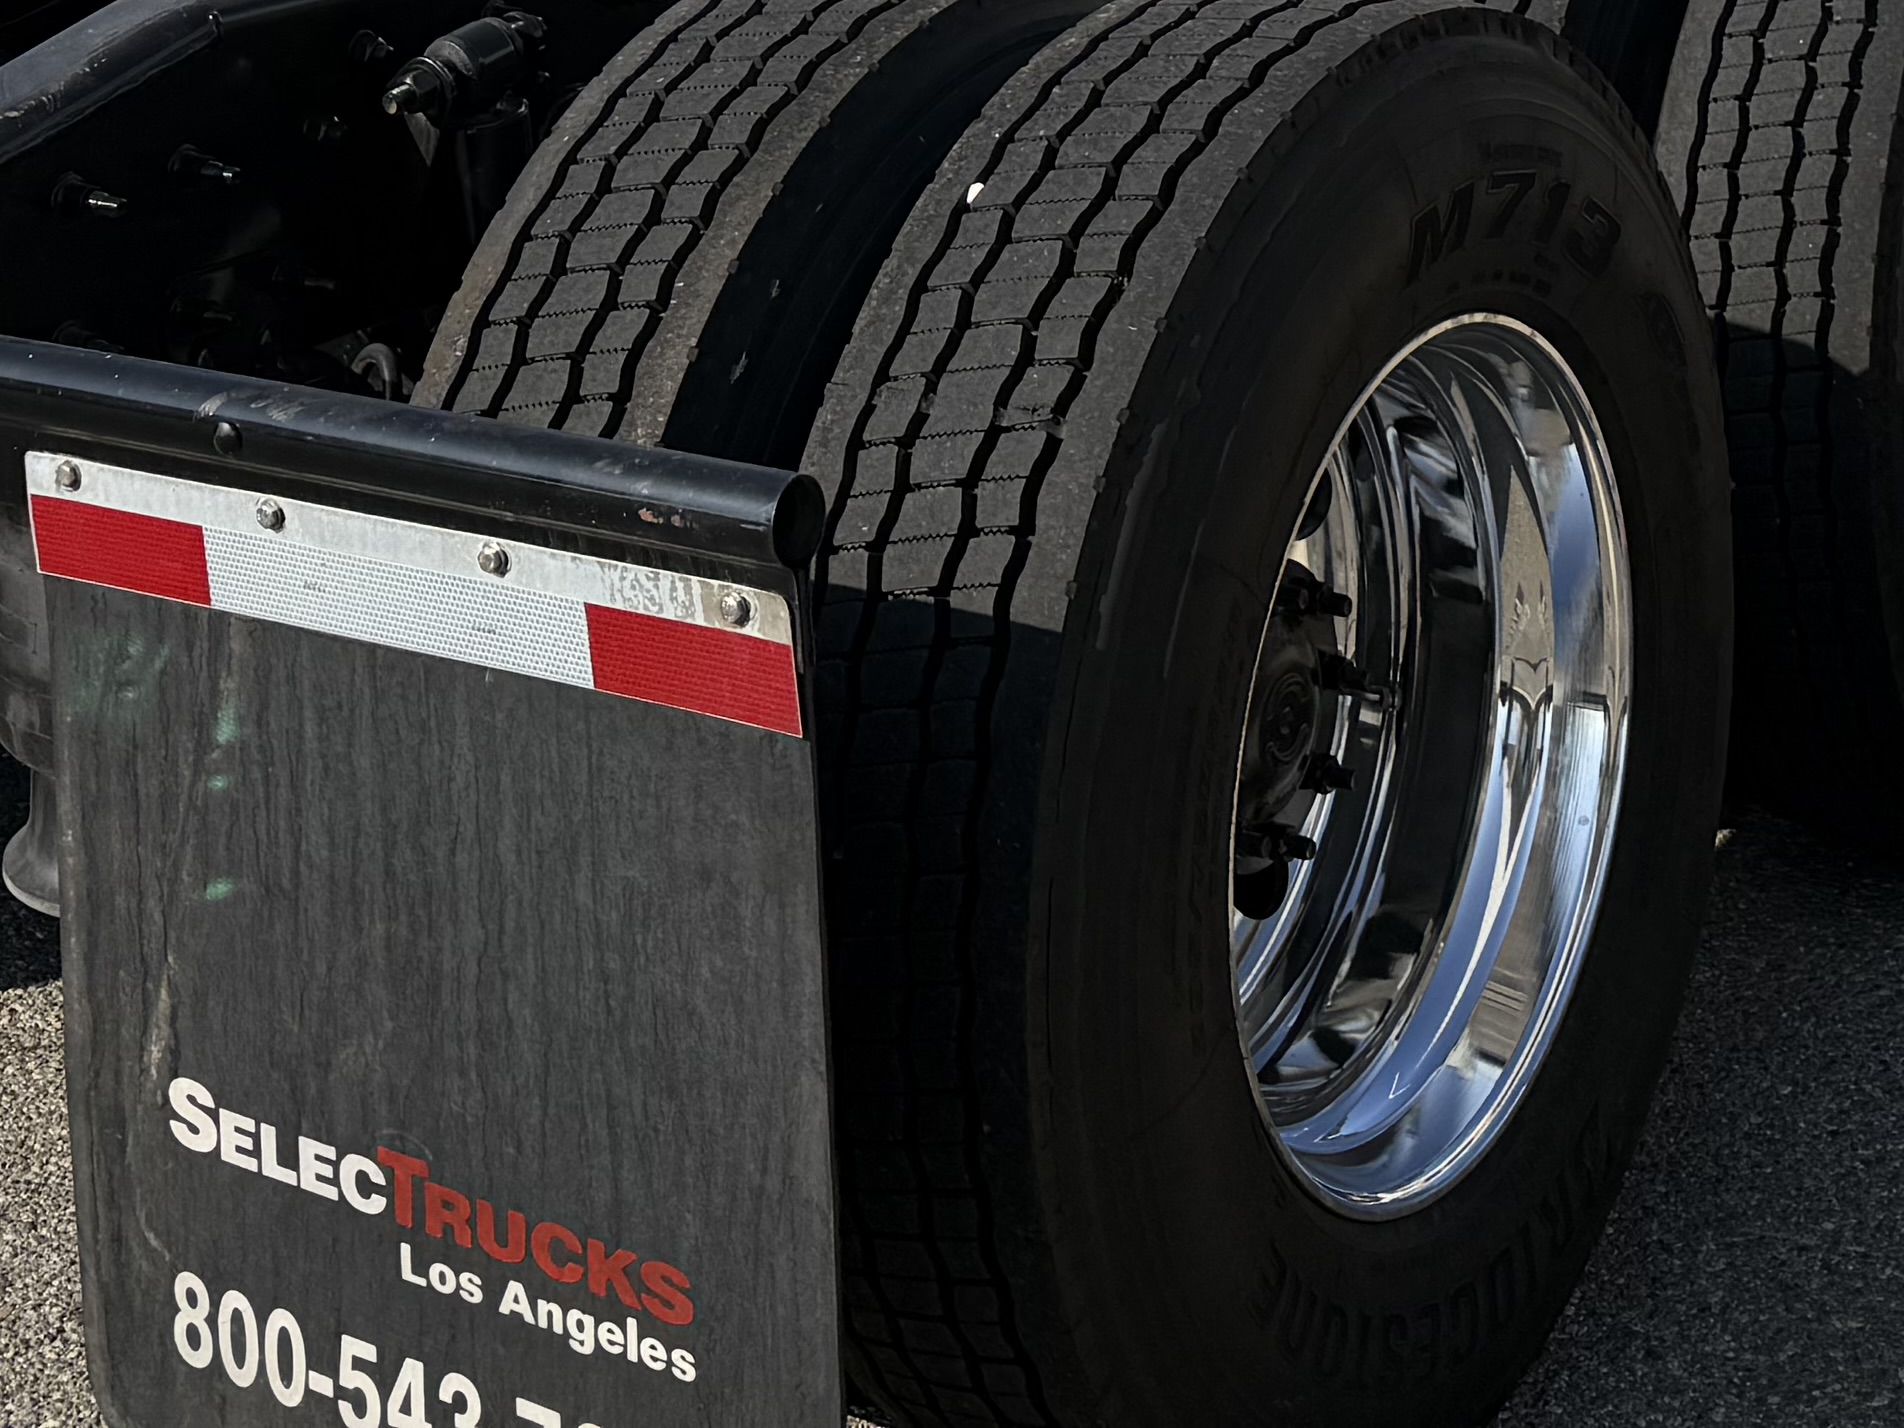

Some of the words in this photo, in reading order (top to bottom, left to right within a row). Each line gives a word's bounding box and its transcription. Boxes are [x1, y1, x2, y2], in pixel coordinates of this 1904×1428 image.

[1404, 168, 1624, 291] M713
[400, 1241, 484, 1304] Los
[498, 1279, 697, 1383] Angeles
